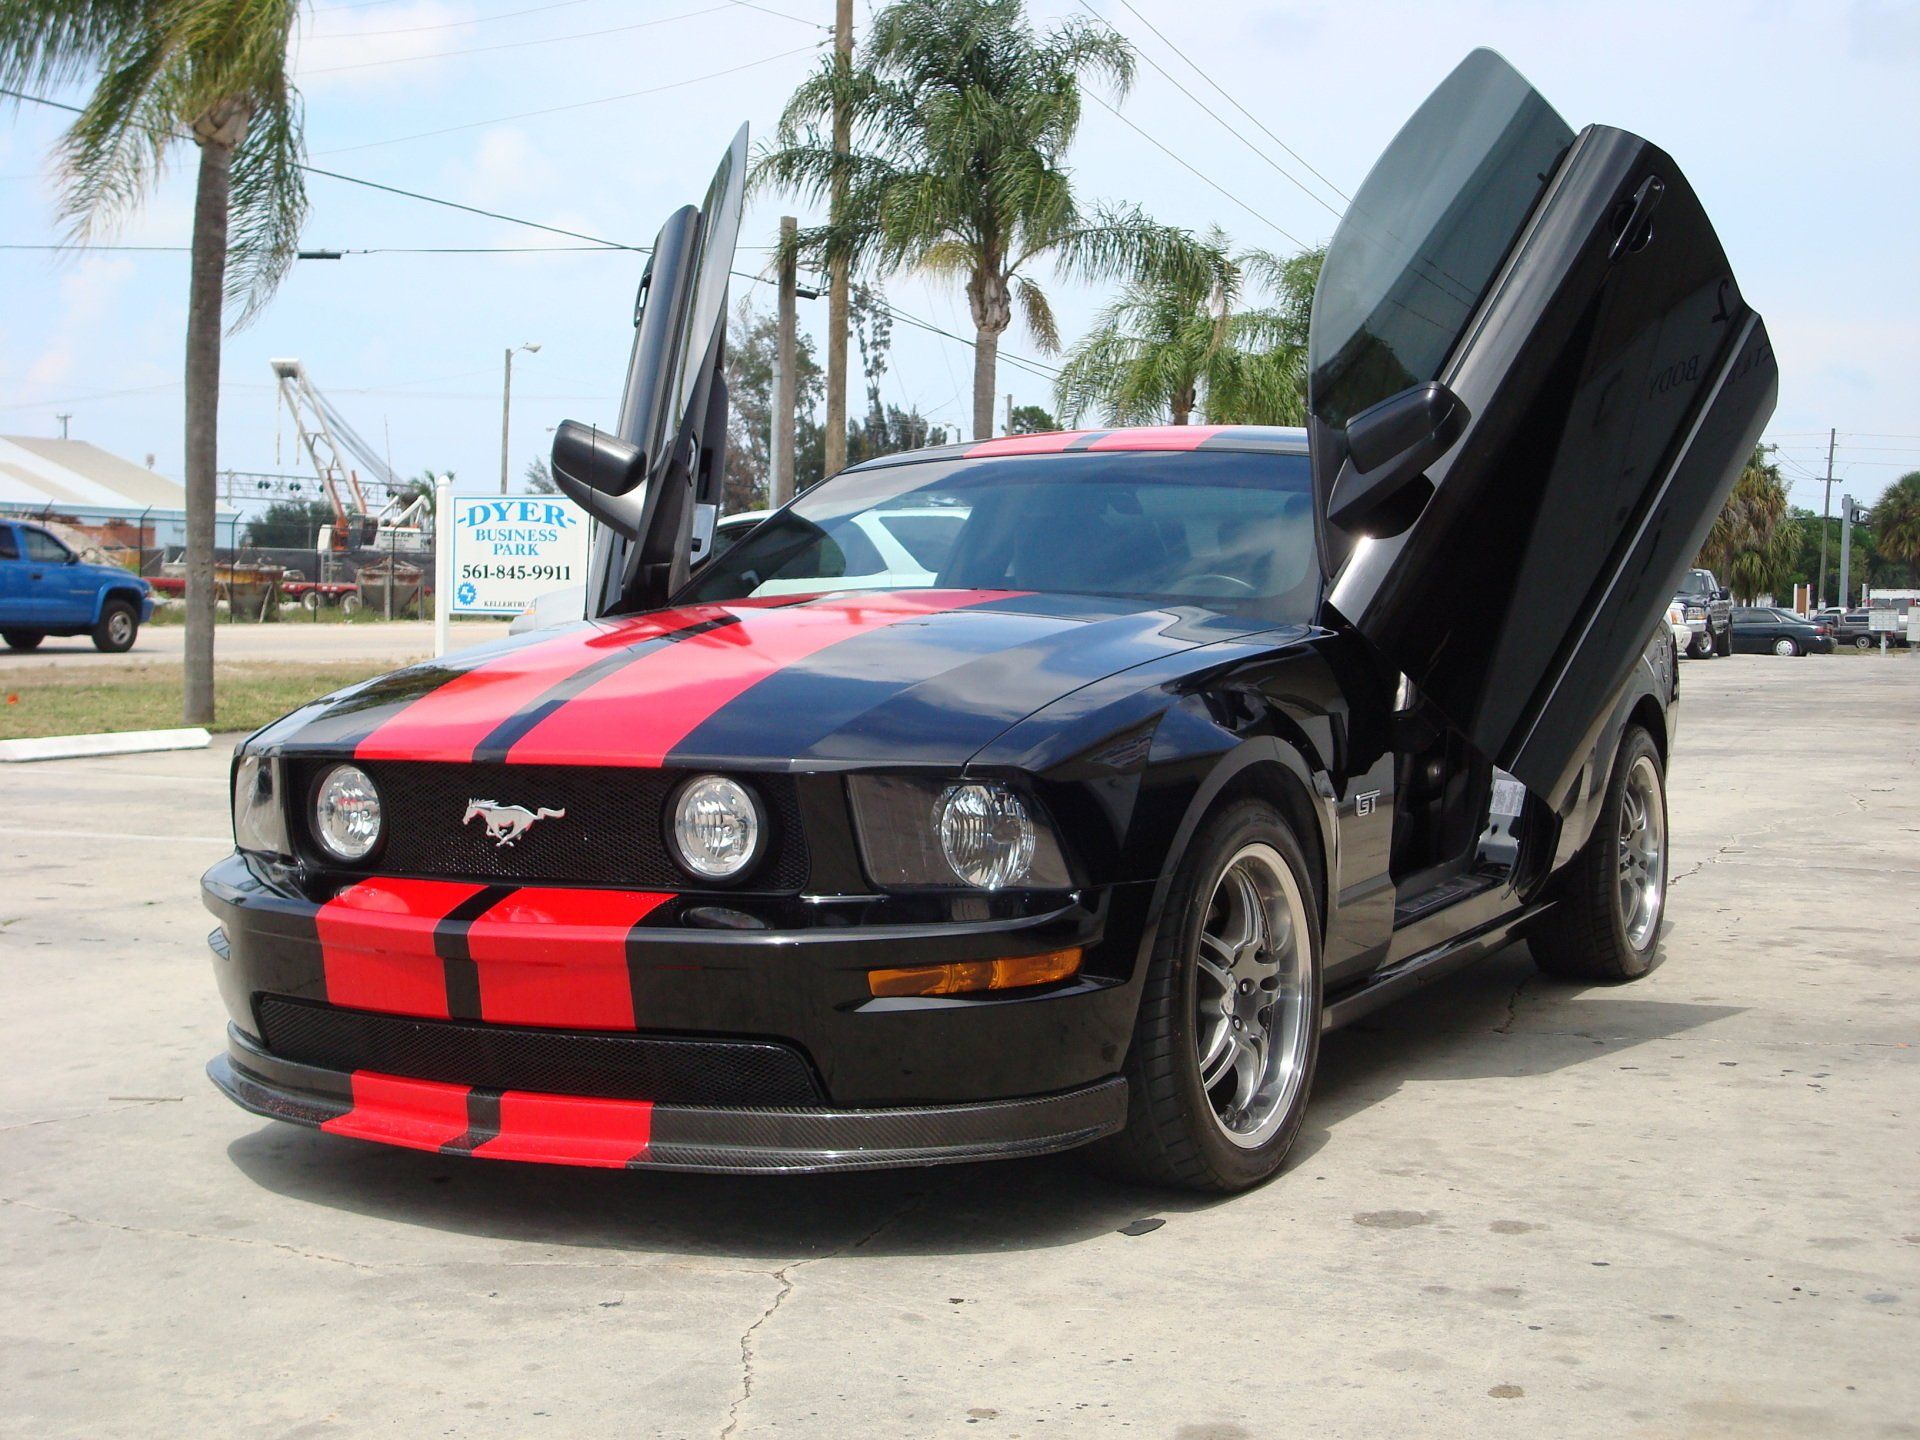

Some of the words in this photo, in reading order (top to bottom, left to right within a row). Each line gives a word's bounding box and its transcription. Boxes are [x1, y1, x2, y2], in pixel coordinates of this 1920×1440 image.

[475, 528, 558, 542] BUSINESS
[493, 543, 539, 556] PARK
[461, 563, 571, 580] 561-845-9911
[1355, 790, 1380, 817] GT
